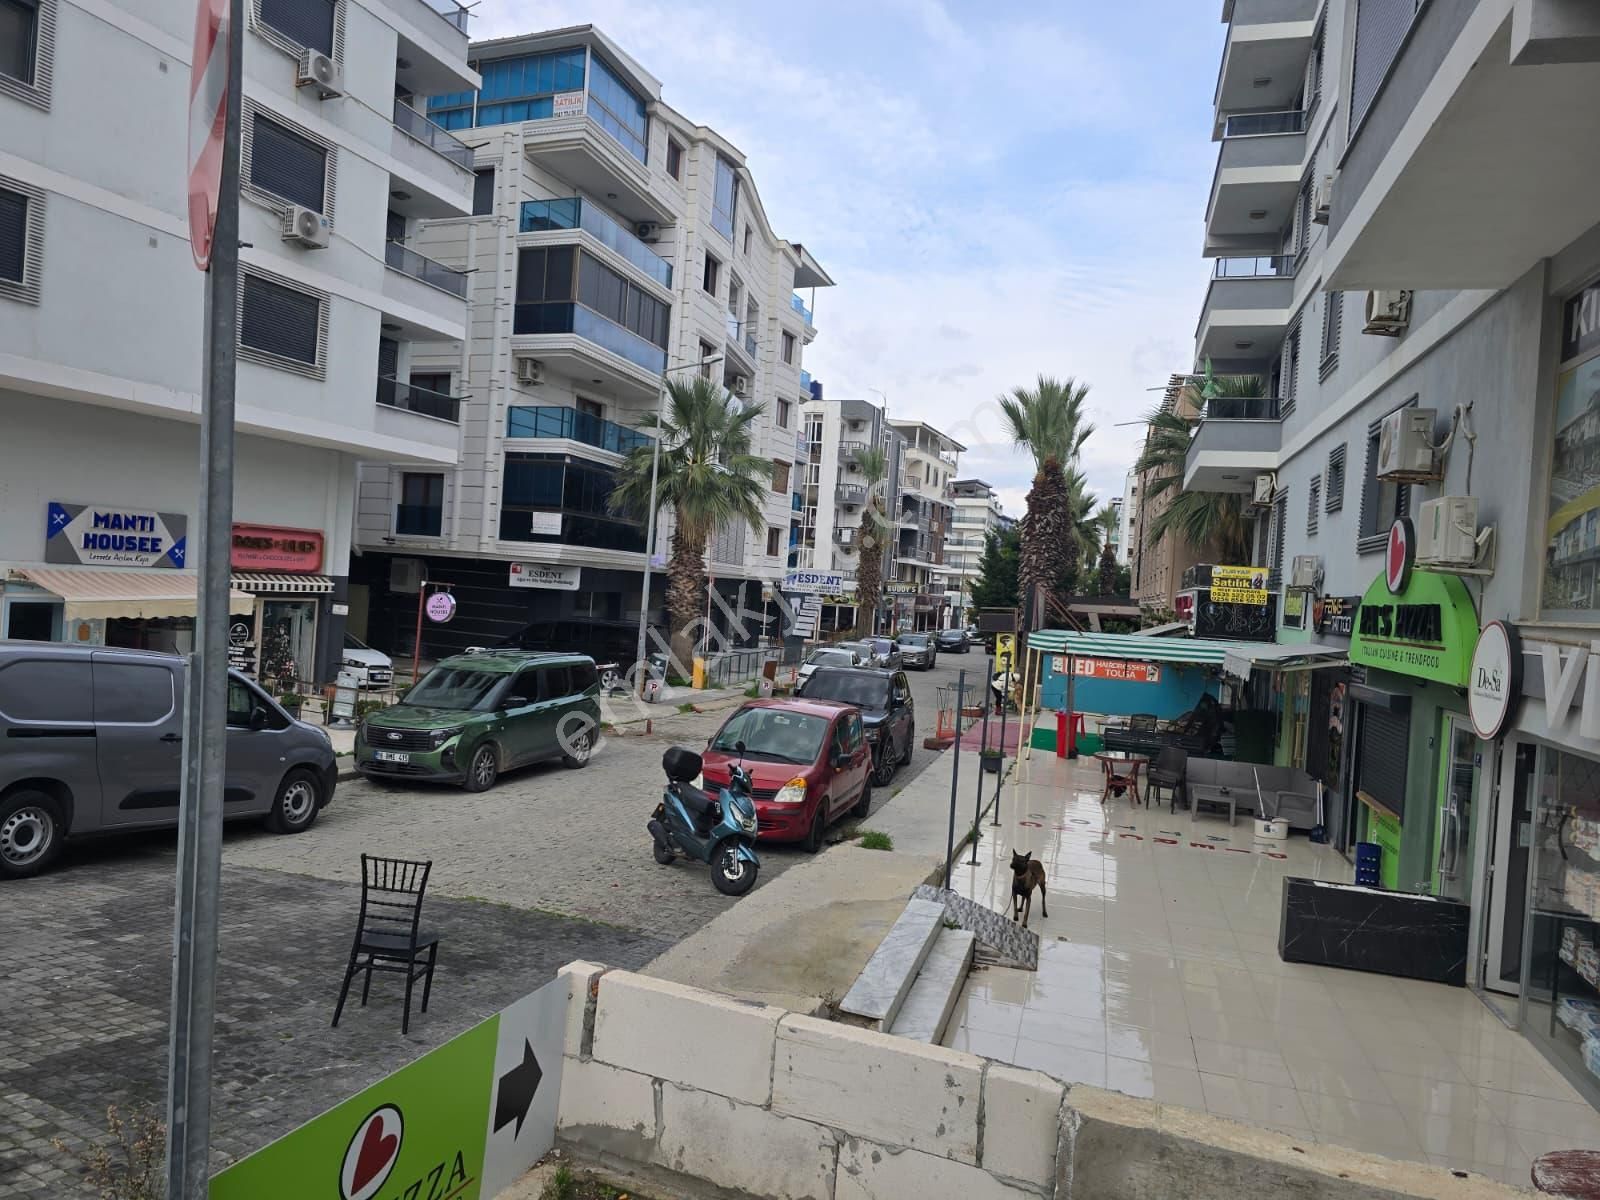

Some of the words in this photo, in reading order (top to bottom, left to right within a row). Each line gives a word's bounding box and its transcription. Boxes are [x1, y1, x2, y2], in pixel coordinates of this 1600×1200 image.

[92, 511, 155, 532] MANTI
[82, 532, 162, 553] HOUSEE
[528, 569, 563, 580] ESDENT
[797, 573, 842, 586] ESDENT
[1096, 659, 1147, 672] HAIRDRESSER
